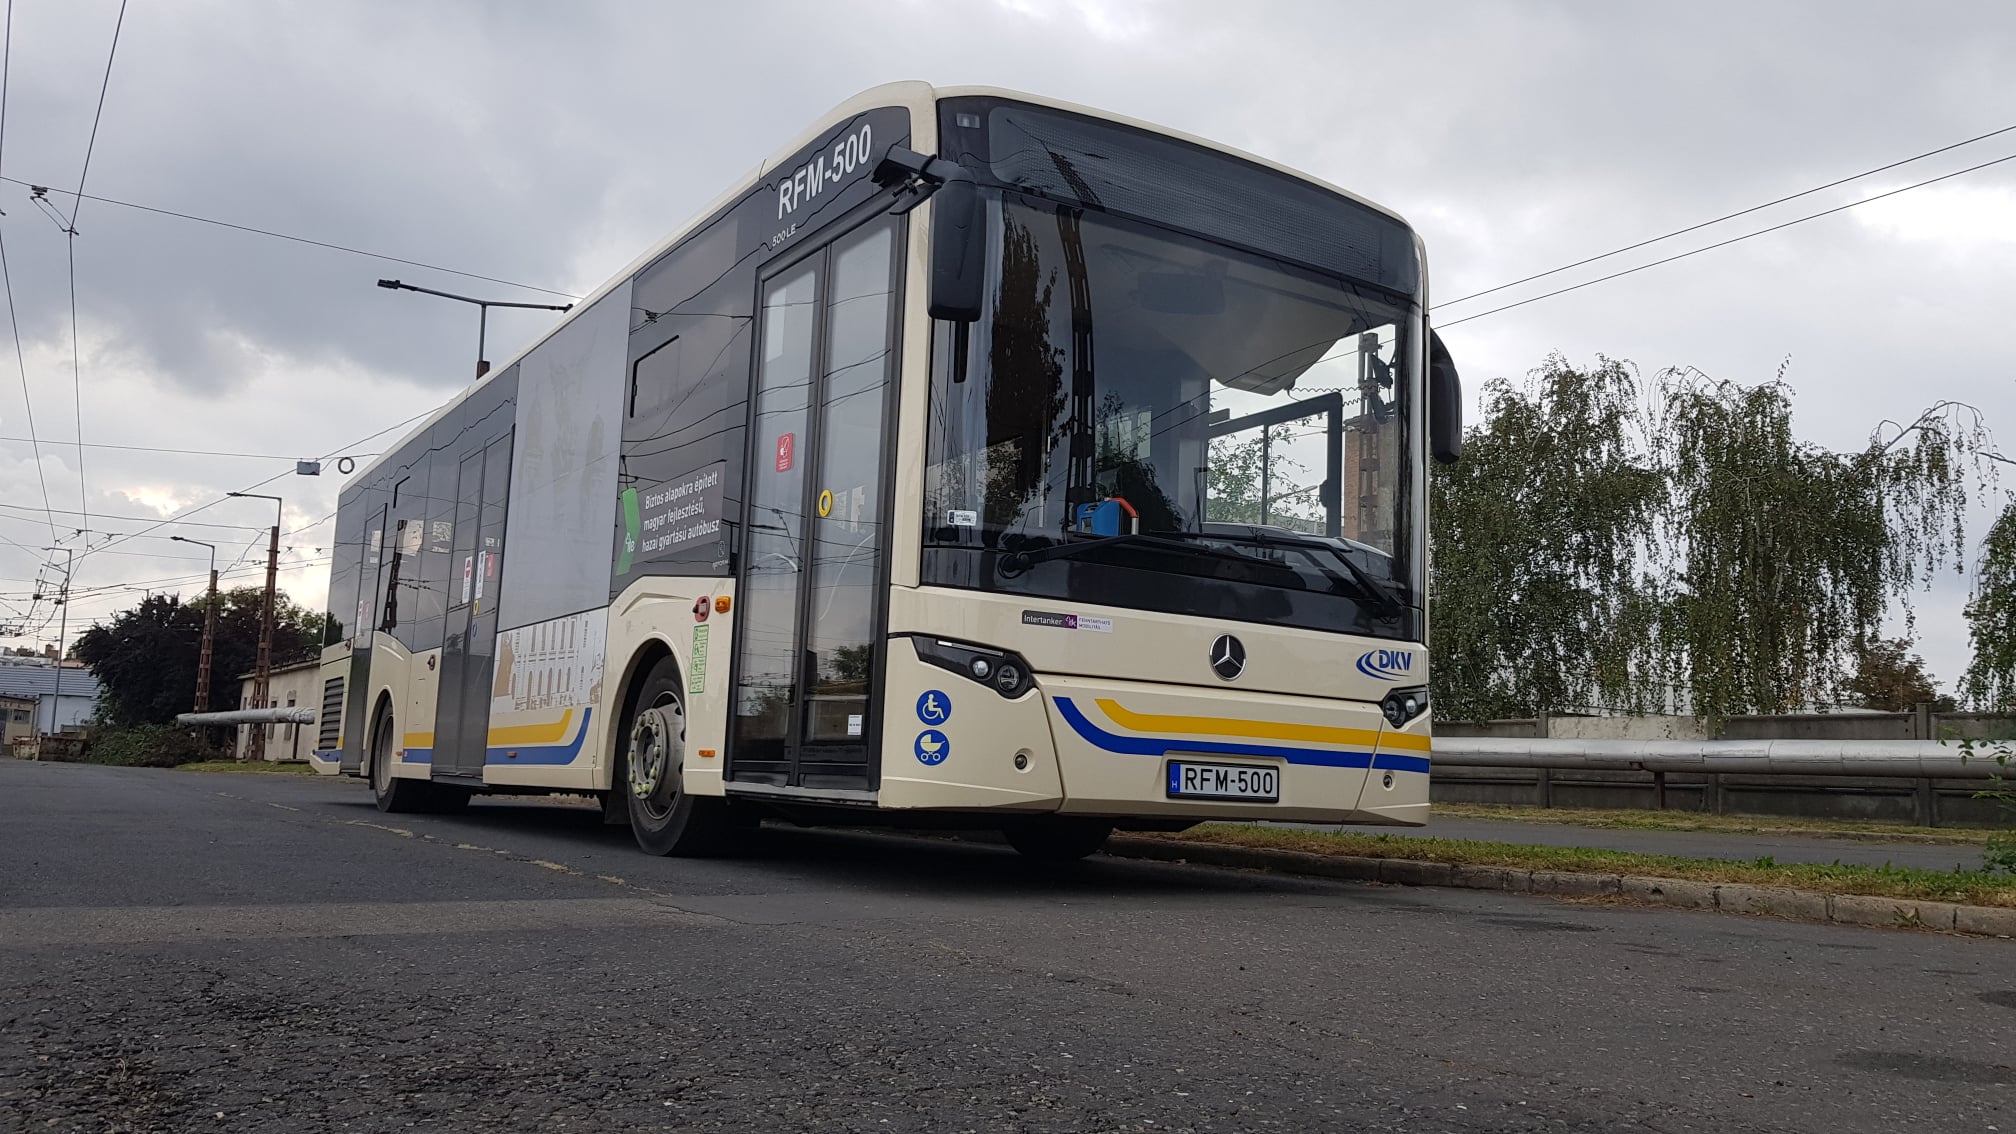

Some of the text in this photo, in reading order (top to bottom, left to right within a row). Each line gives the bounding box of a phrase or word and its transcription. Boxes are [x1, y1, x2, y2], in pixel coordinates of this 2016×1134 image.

[778, 124, 872, 220] RFM-500
[772, 223, 796, 247] 500 LE
[645, 471, 718, 510] Biztos alapokra épített
[643, 513, 667, 532] magyar
[641, 534, 658, 553] hazai
[658, 524, 687, 552] gyártású
[687, 519, 720, 539] autóbusz
[1024, 614, 1063, 626] Intertanker
[1378, 649, 1412, 671] DKV
[1171, 767, 1274, 795] H RFM-500
